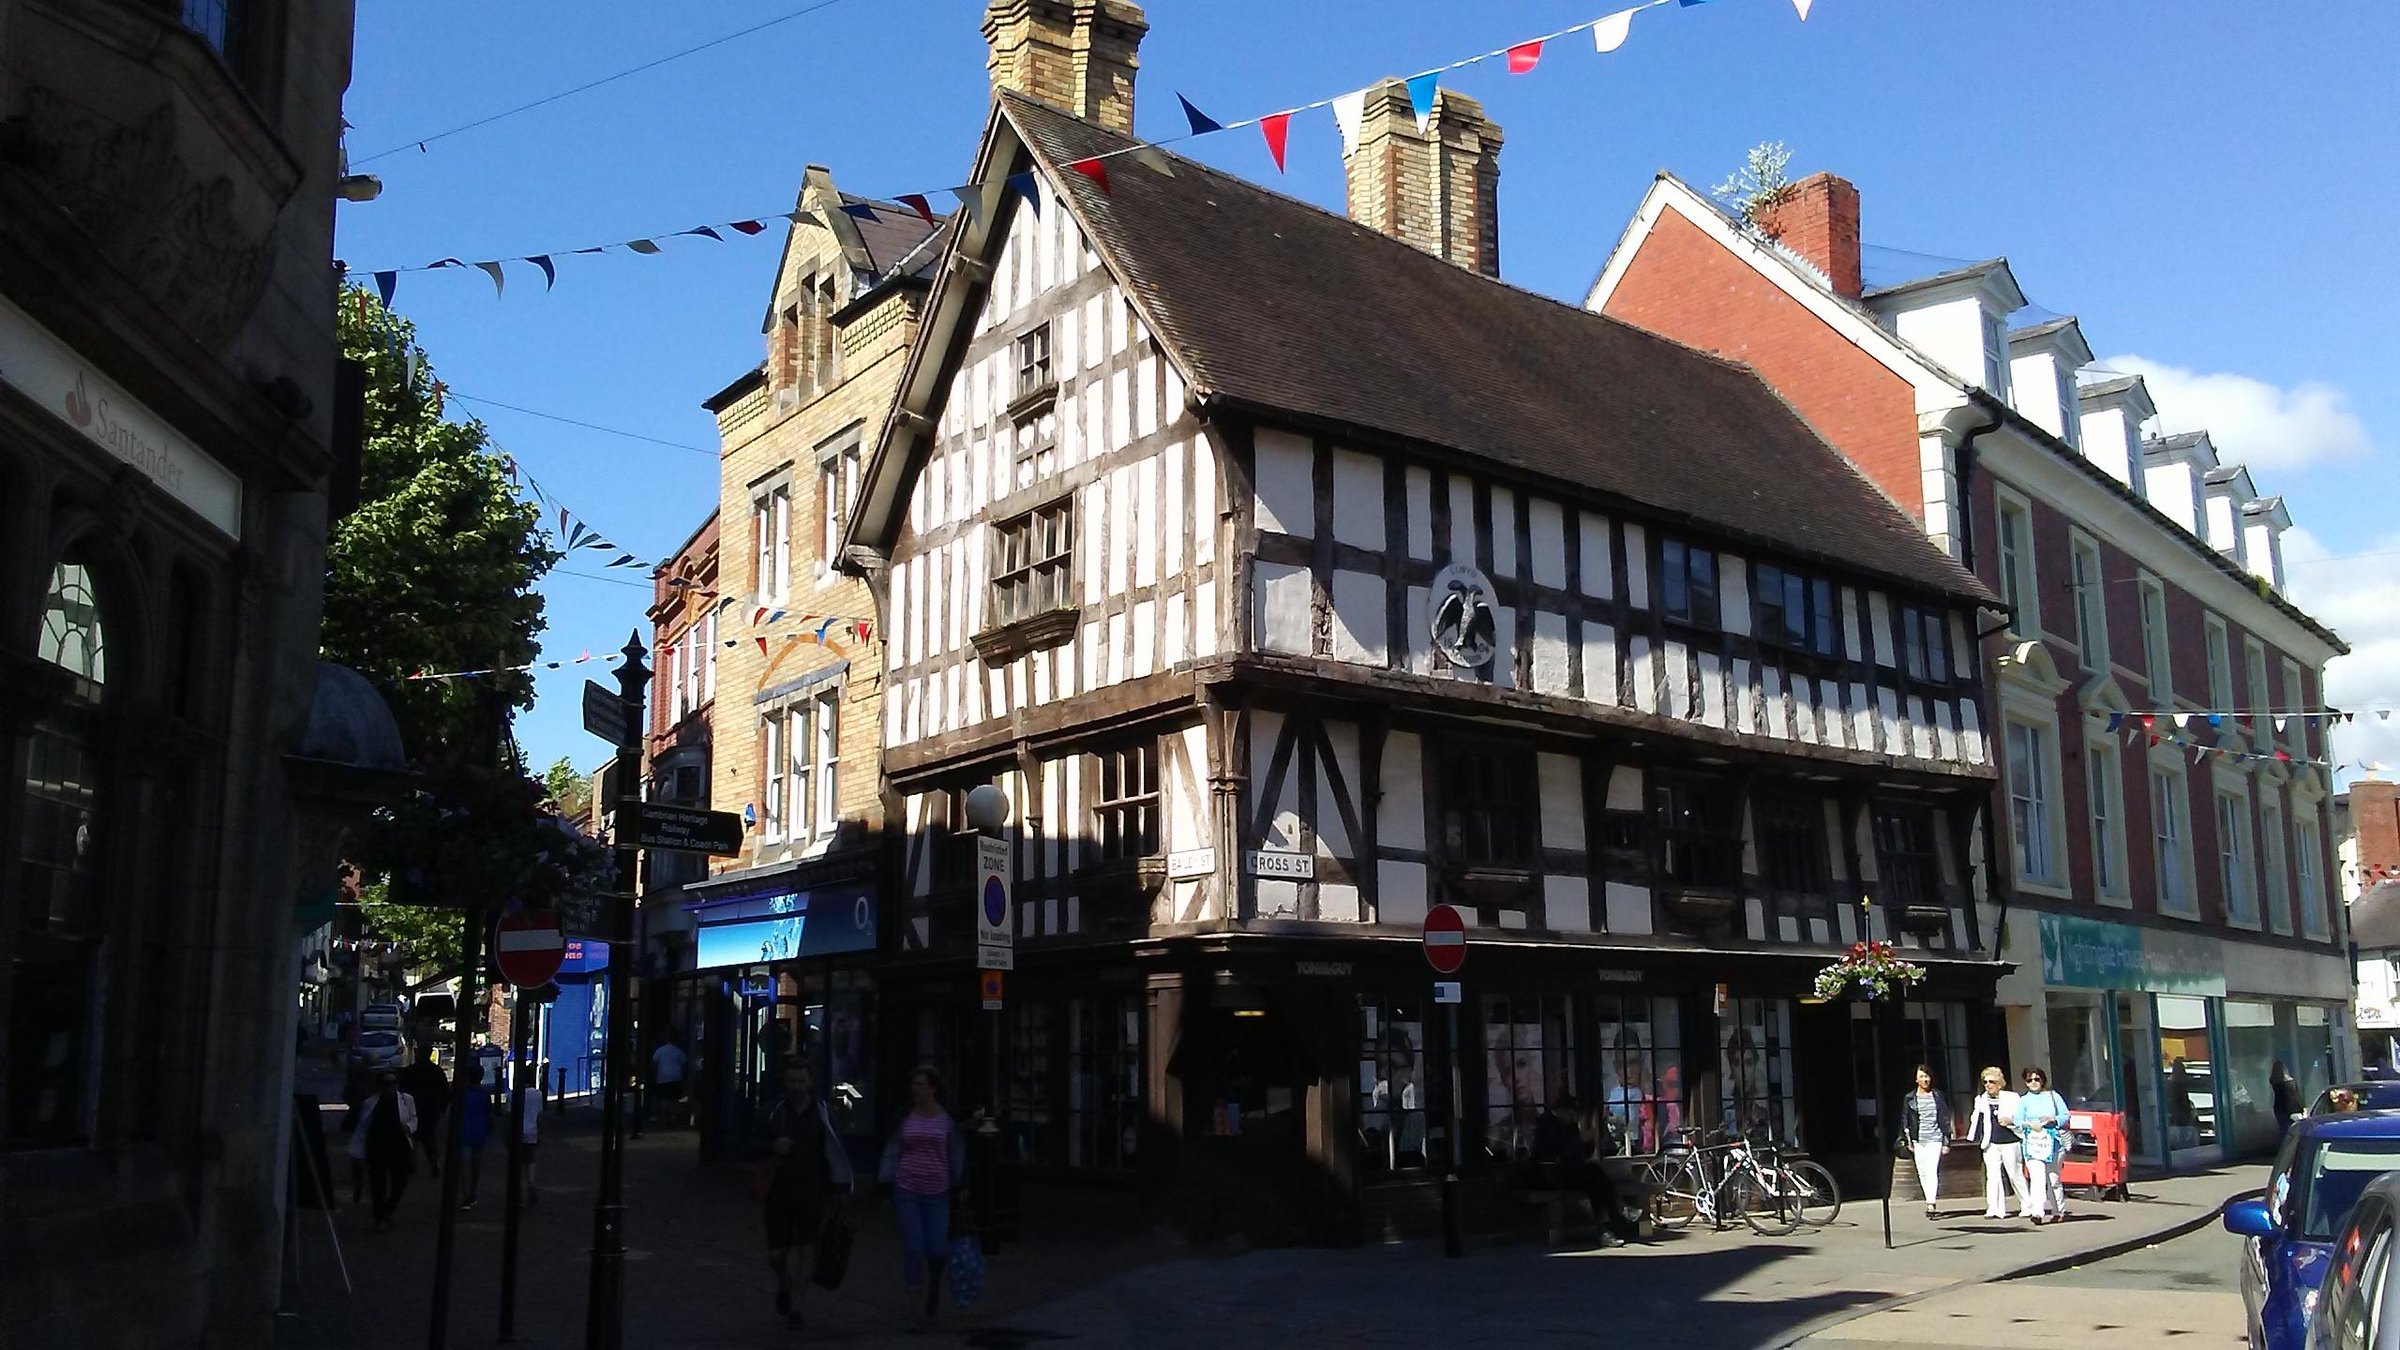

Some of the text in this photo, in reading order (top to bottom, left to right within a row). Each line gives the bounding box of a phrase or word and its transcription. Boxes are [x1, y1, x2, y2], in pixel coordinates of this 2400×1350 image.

[96, 398, 183, 491] Santander
[984, 856, 1005, 872] ZONE
[1251, 856, 1289, 872] CROSS
[2062, 934, 2116, 974] Nightingale
